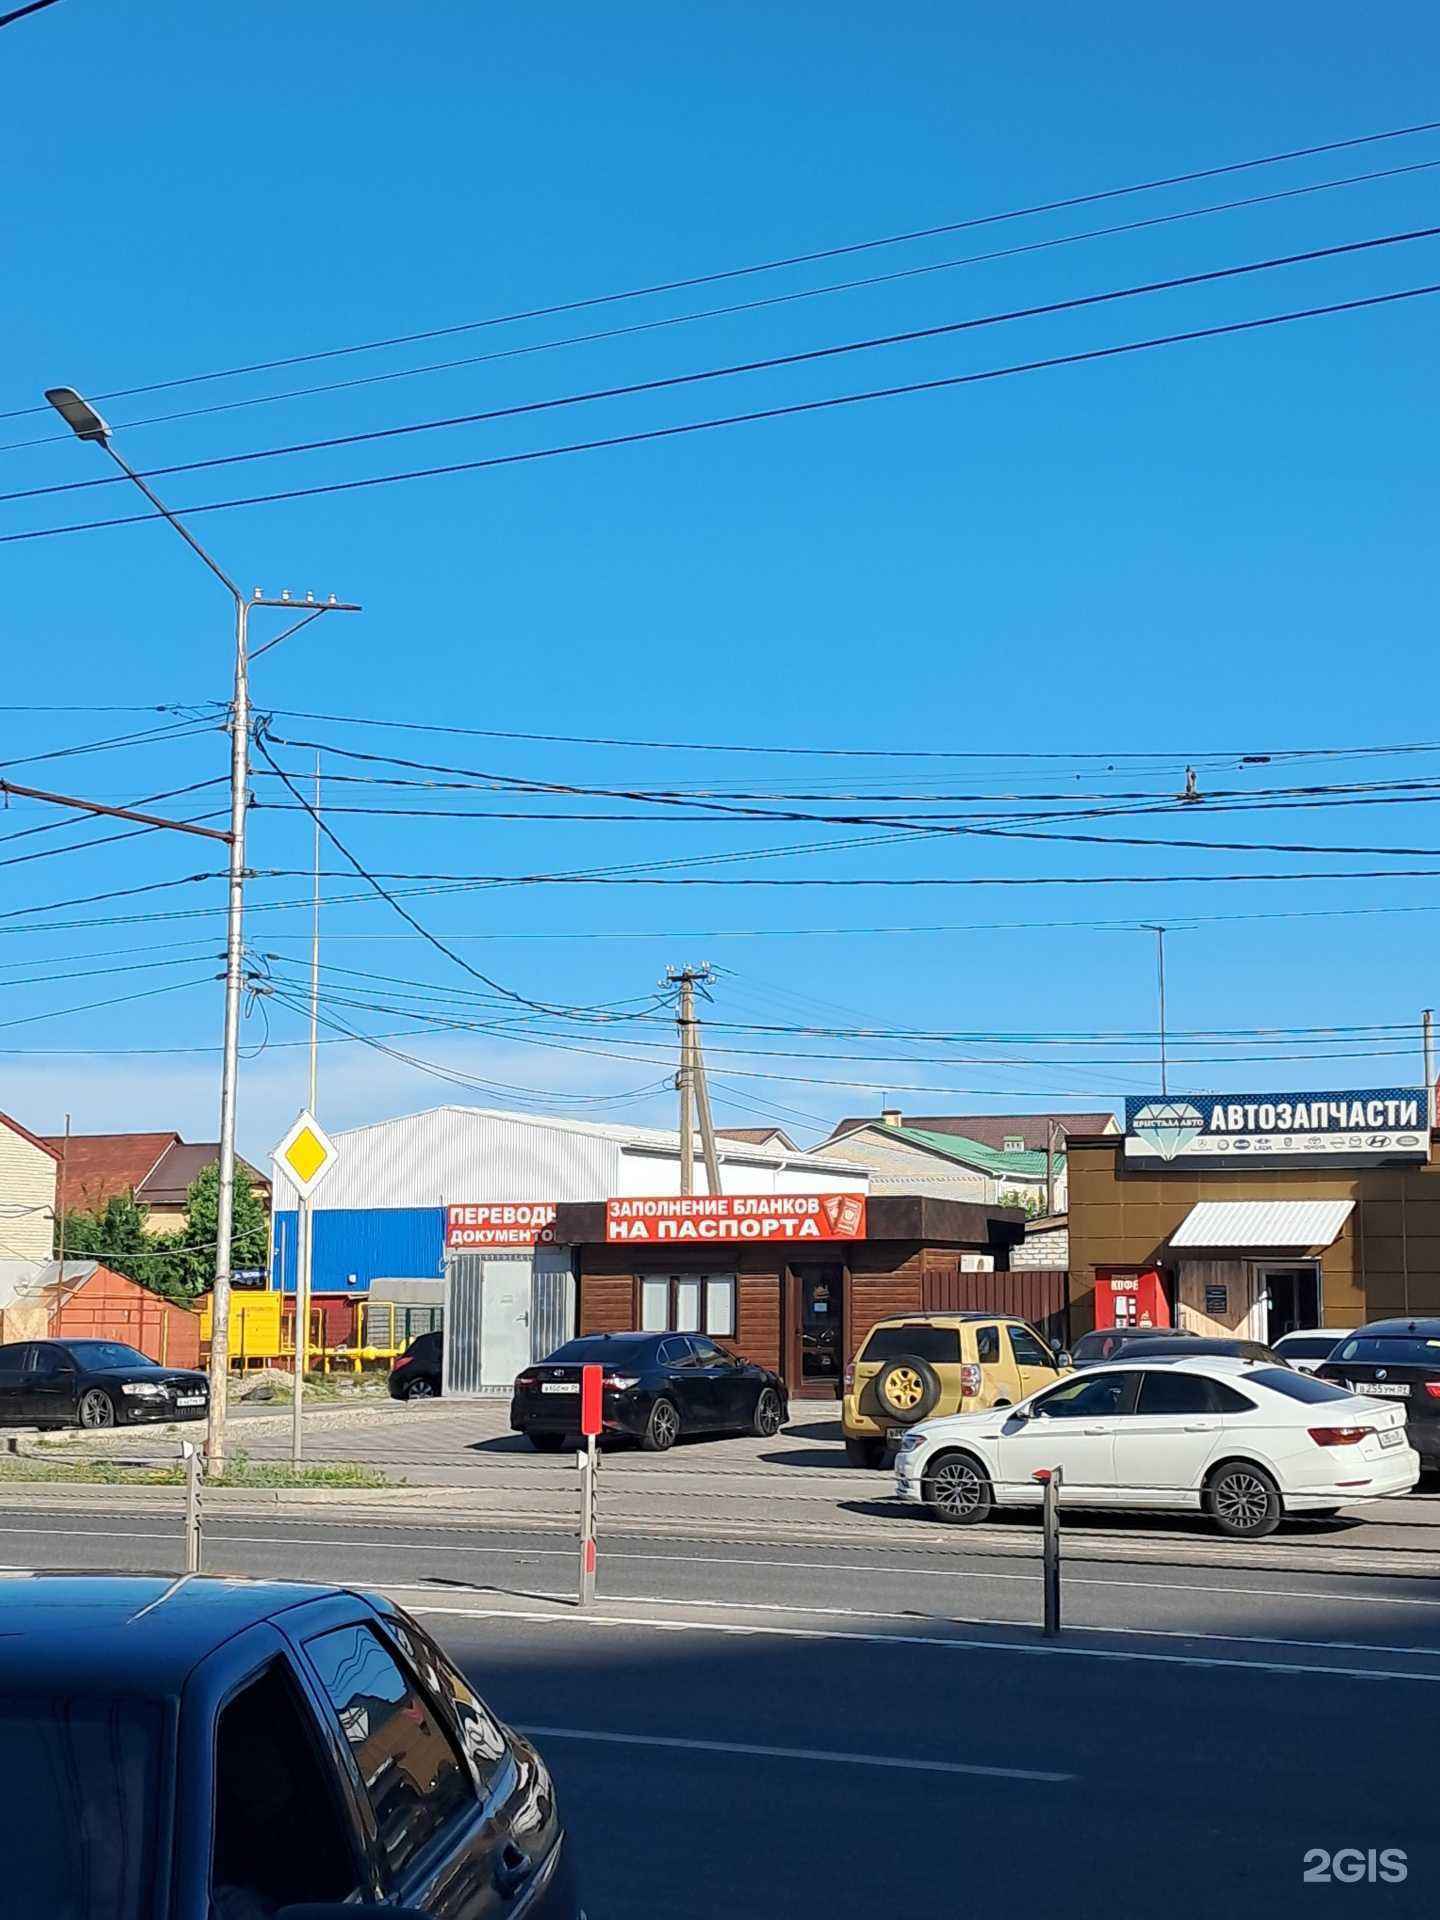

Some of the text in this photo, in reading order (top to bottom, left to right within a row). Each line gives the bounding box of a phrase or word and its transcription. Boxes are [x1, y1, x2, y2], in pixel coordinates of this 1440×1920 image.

[1180, 1119, 1204, 1127] АВТО
[1210, 1100, 1418, 1131] АВТОЗАПЧАСТИ
[608, 1197, 819, 1218] ЗАПОЛНЕНИЕ БЛАНКОВ
[609, 1218, 821, 1238] НА ПАСПОРТА
[1111, 1279, 1139, 1291] КОФЕ
